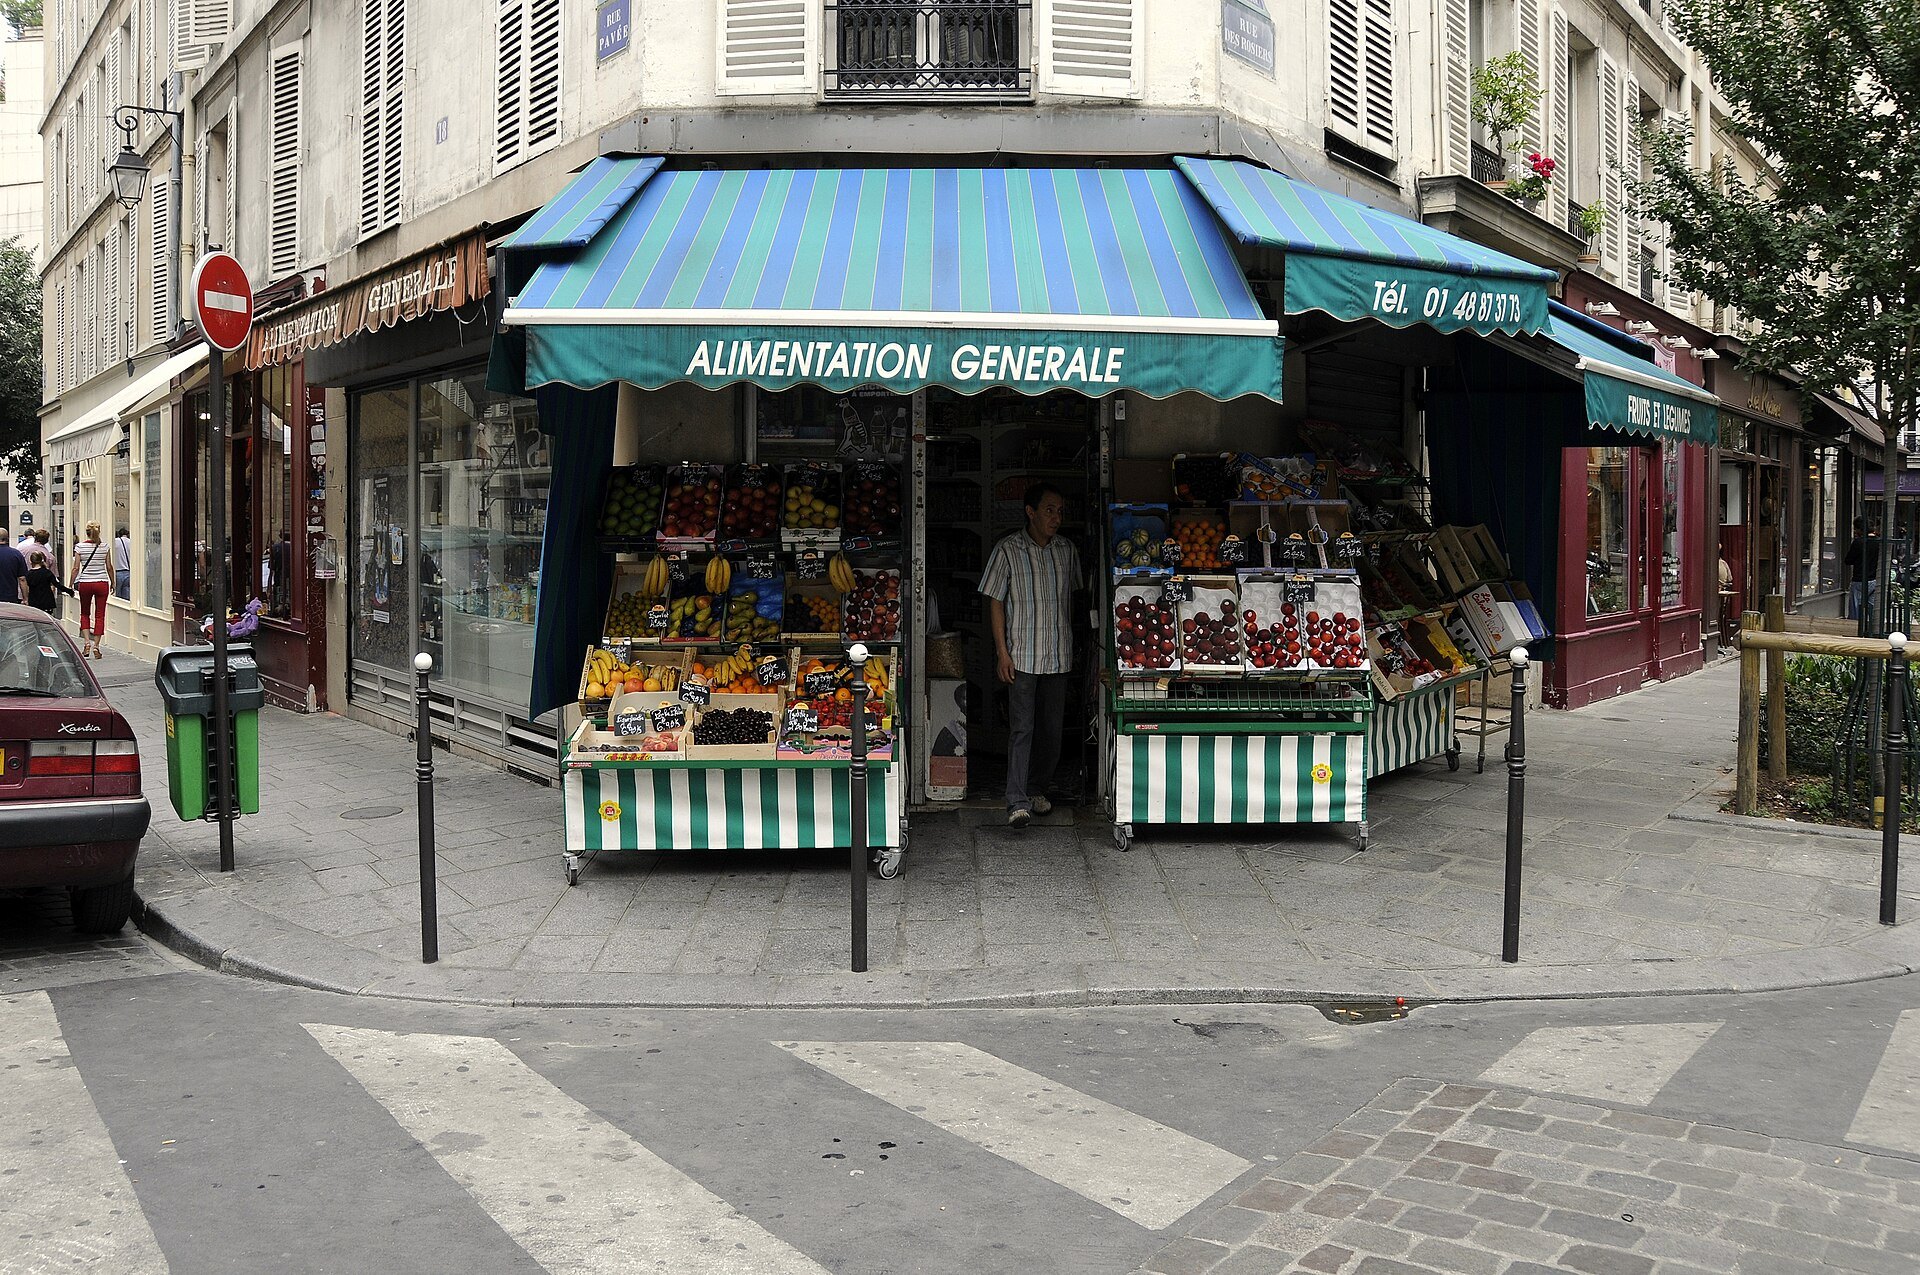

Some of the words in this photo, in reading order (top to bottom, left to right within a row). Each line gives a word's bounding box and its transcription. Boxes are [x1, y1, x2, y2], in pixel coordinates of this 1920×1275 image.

[606, 8, 622, 28] RUE
[1239, 17, 1258, 38] RUE
[599, 24, 629, 51] PAVÉE
[1224, 27, 1240, 47] DES
[1240, 37, 1273, 64] ROSIERS
[437, 120, 447, 142] 18
[1372, 279, 1409, 315] Tél.
[1423, 287, 1449, 318] 01
[1452, 291, 1477, 321] 48
[1477, 292, 1493, 322] 87
[1494, 293, 1508, 322] 37
[1508, 294, 1521, 323] 73
[685, 340, 933, 379] ALIMENTATION
[951, 344, 1125, 383] GENERALE
[1627, 395, 1651, 427] FRUITS
[1653, 401, 1661, 429] ET
[1663, 403, 1692, 434] LEGUMES
[57, 722, 102, 735] Xantia
